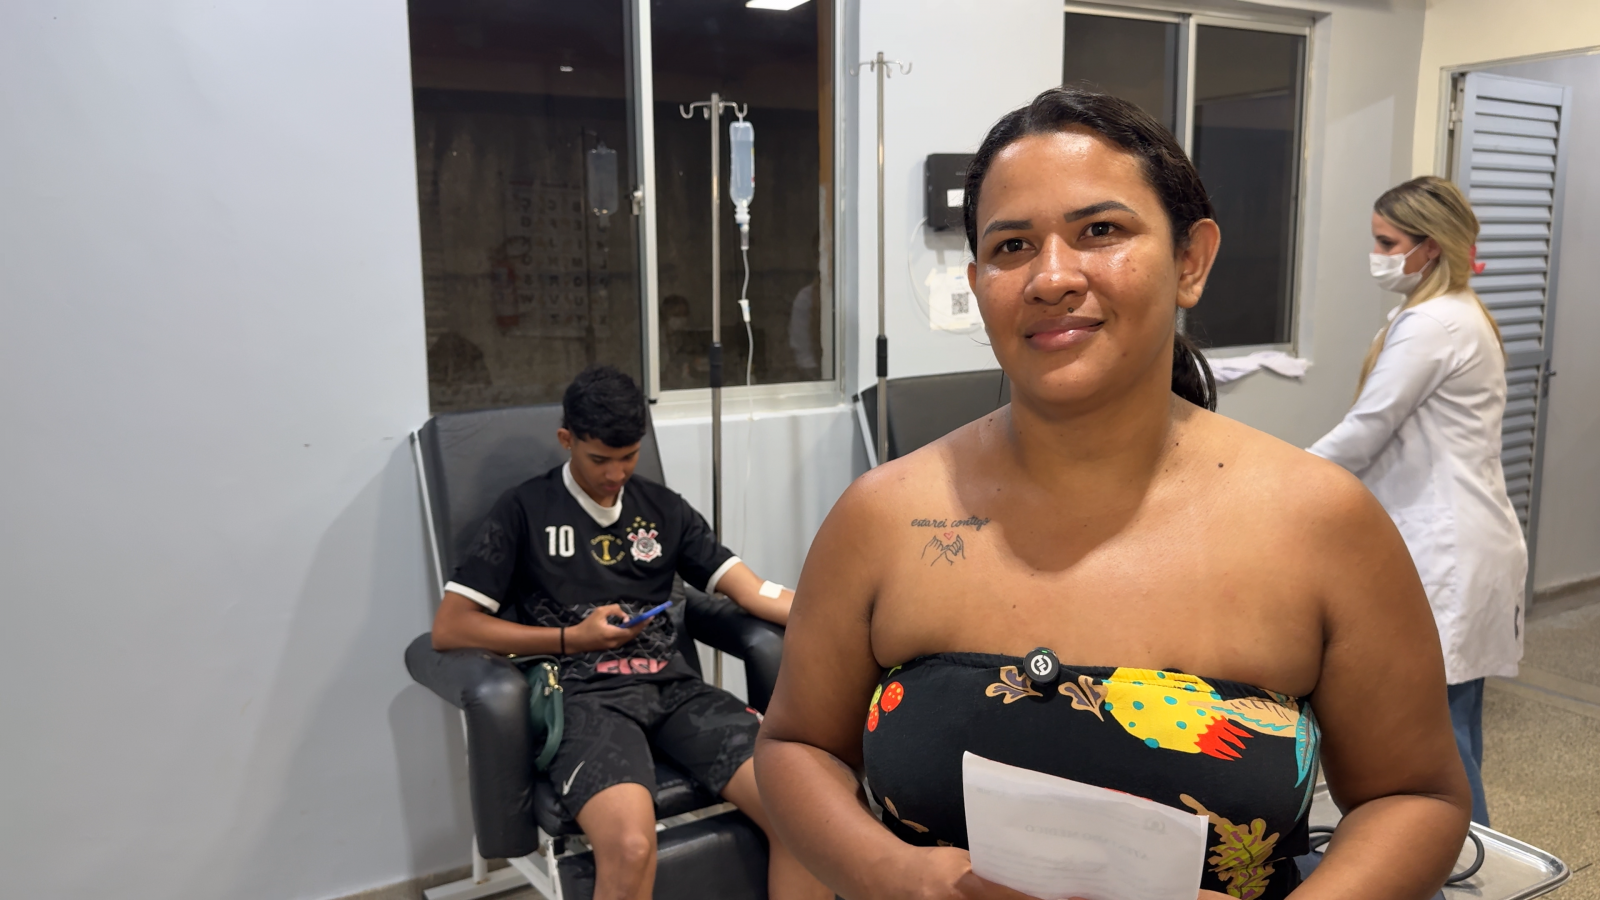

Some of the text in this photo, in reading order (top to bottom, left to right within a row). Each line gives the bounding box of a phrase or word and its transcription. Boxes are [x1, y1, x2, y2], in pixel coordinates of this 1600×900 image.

[911, 515, 991, 531] estarei contigo
[545, 525, 575, 557] 10
